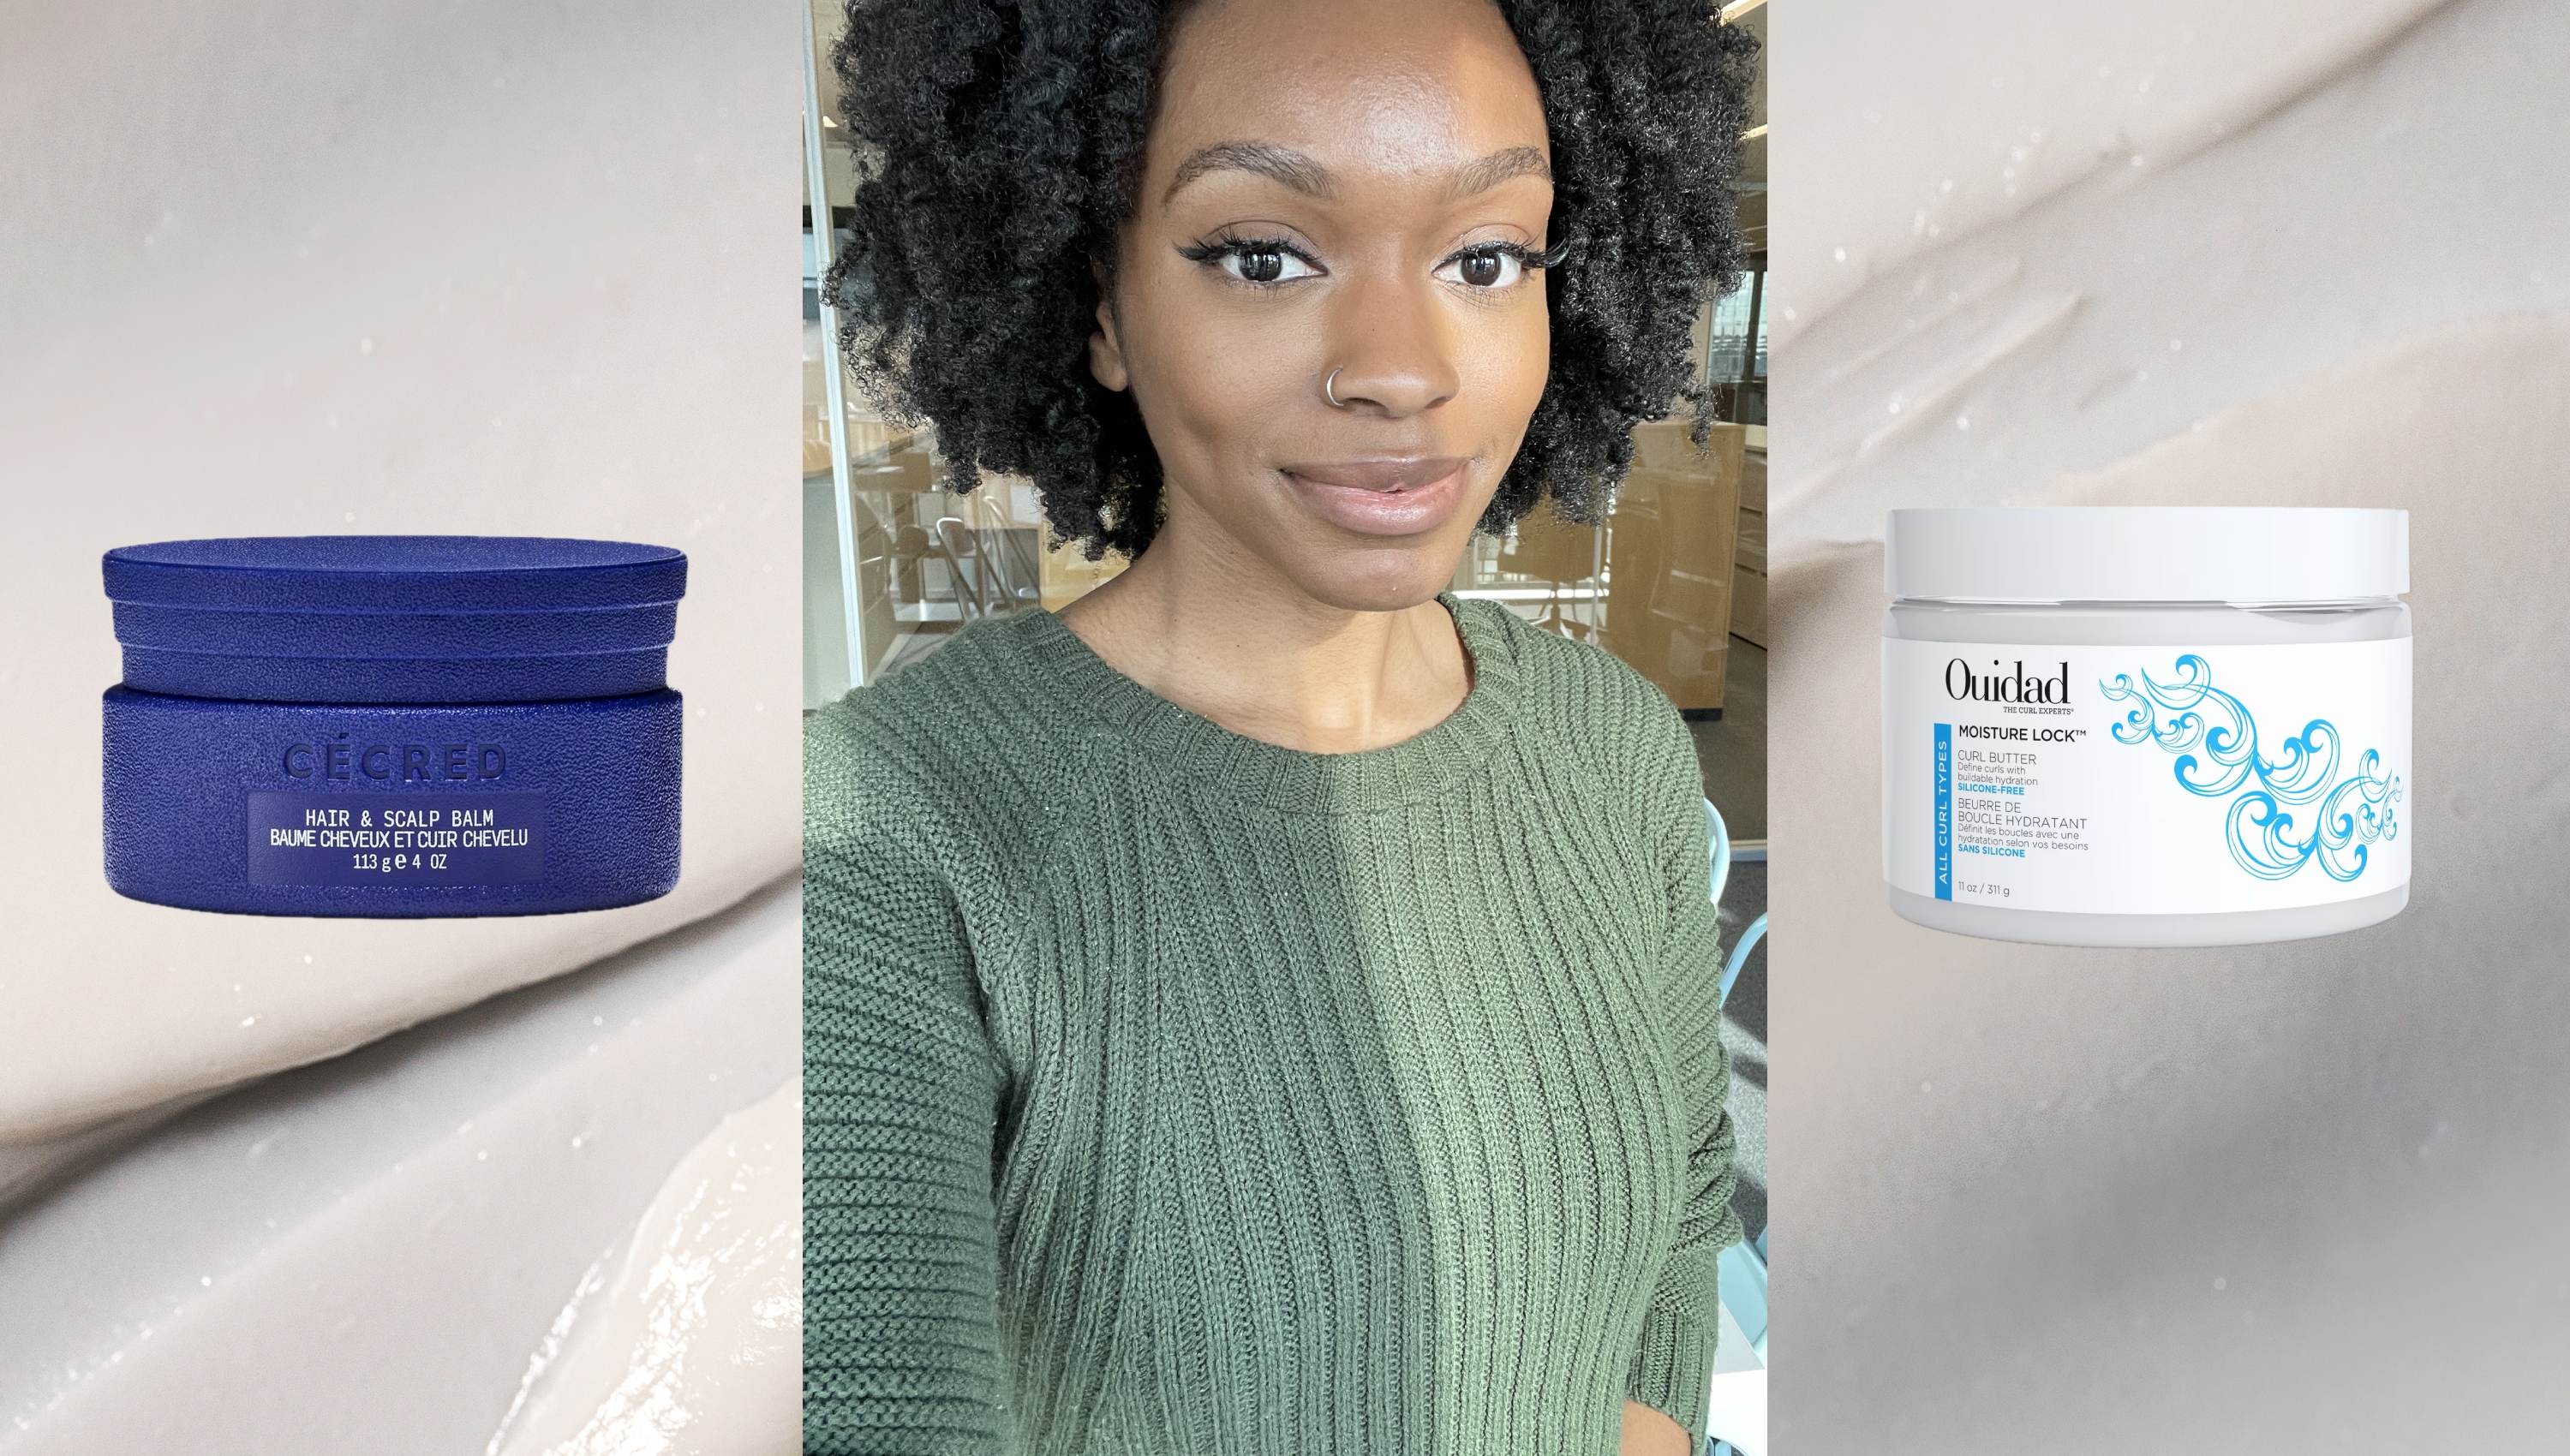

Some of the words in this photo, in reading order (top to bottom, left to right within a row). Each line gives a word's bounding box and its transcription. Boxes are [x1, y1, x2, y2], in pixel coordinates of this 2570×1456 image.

[1945, 658, 2071, 704] Ouidad
[1959, 725, 2028, 741] MOISTURE
[284, 732, 507, 781] CÉCRED
[1957, 749, 1986, 762] CURL
[1990, 752, 2036, 765] BUTTER
[1938, 740, 1947, 795] TYPES
[1957, 762, 1982, 772] Define
[1985, 764, 2004, 774] curls
[2006, 765, 2026, 775] with
[1957, 773, 1993, 784] buildable
[1995, 775, 2038, 786] hydration
[1957, 783, 2024, 796] SILICONE-FREE
[1958, 797, 2001, 812] BEURRE
[2005, 802, 2022, 814] DE
[306, 809, 350, 826] HAIR
[361, 810, 373, 827] &
[384, 810, 440, 827] SCALP
[451, 809, 493, 827] BALM
[1939, 801, 1948, 846] CURL
[1958, 811, 2002, 825] BOUCLE
[2006, 815, 2087, 829] HYDRATANT
[270, 828, 316, 847] BAUME
[320, 831, 390, 848] CHEVEUX
[394, 831, 414, 848] ET
[417, 831, 457, 848] CUIR
[463, 829, 528, 848] CHEVELU
[1958, 823, 1983, 834] Définit
[1985, 825, 1997, 835] les
[1999, 827, 2033, 838] boucles
[2035, 830, 2058, 839] avec
[2060, 831, 2079, 840] une
[1957, 833, 2004, 846] hydratation
[2005, 838, 2029, 848] selon
[2032, 840, 2048, 849] vos
[2052, 840, 2089, 850] besoins
[1957, 844, 1980, 854] SANS
[1981, 845, 2025, 858] SILICONE
[353, 855, 377, 869] 113
[382, 857, 391, 872] g
[412, 855, 421, 869] 4
[430, 855, 447, 869] OZ
[1939, 852, 1948, 885] ALL
[1958, 881, 1965, 891] 11
[1967, 884, 1977, 892] oz
[1987, 884, 2000, 895] 311
[2003, 886, 2010, 897] g
